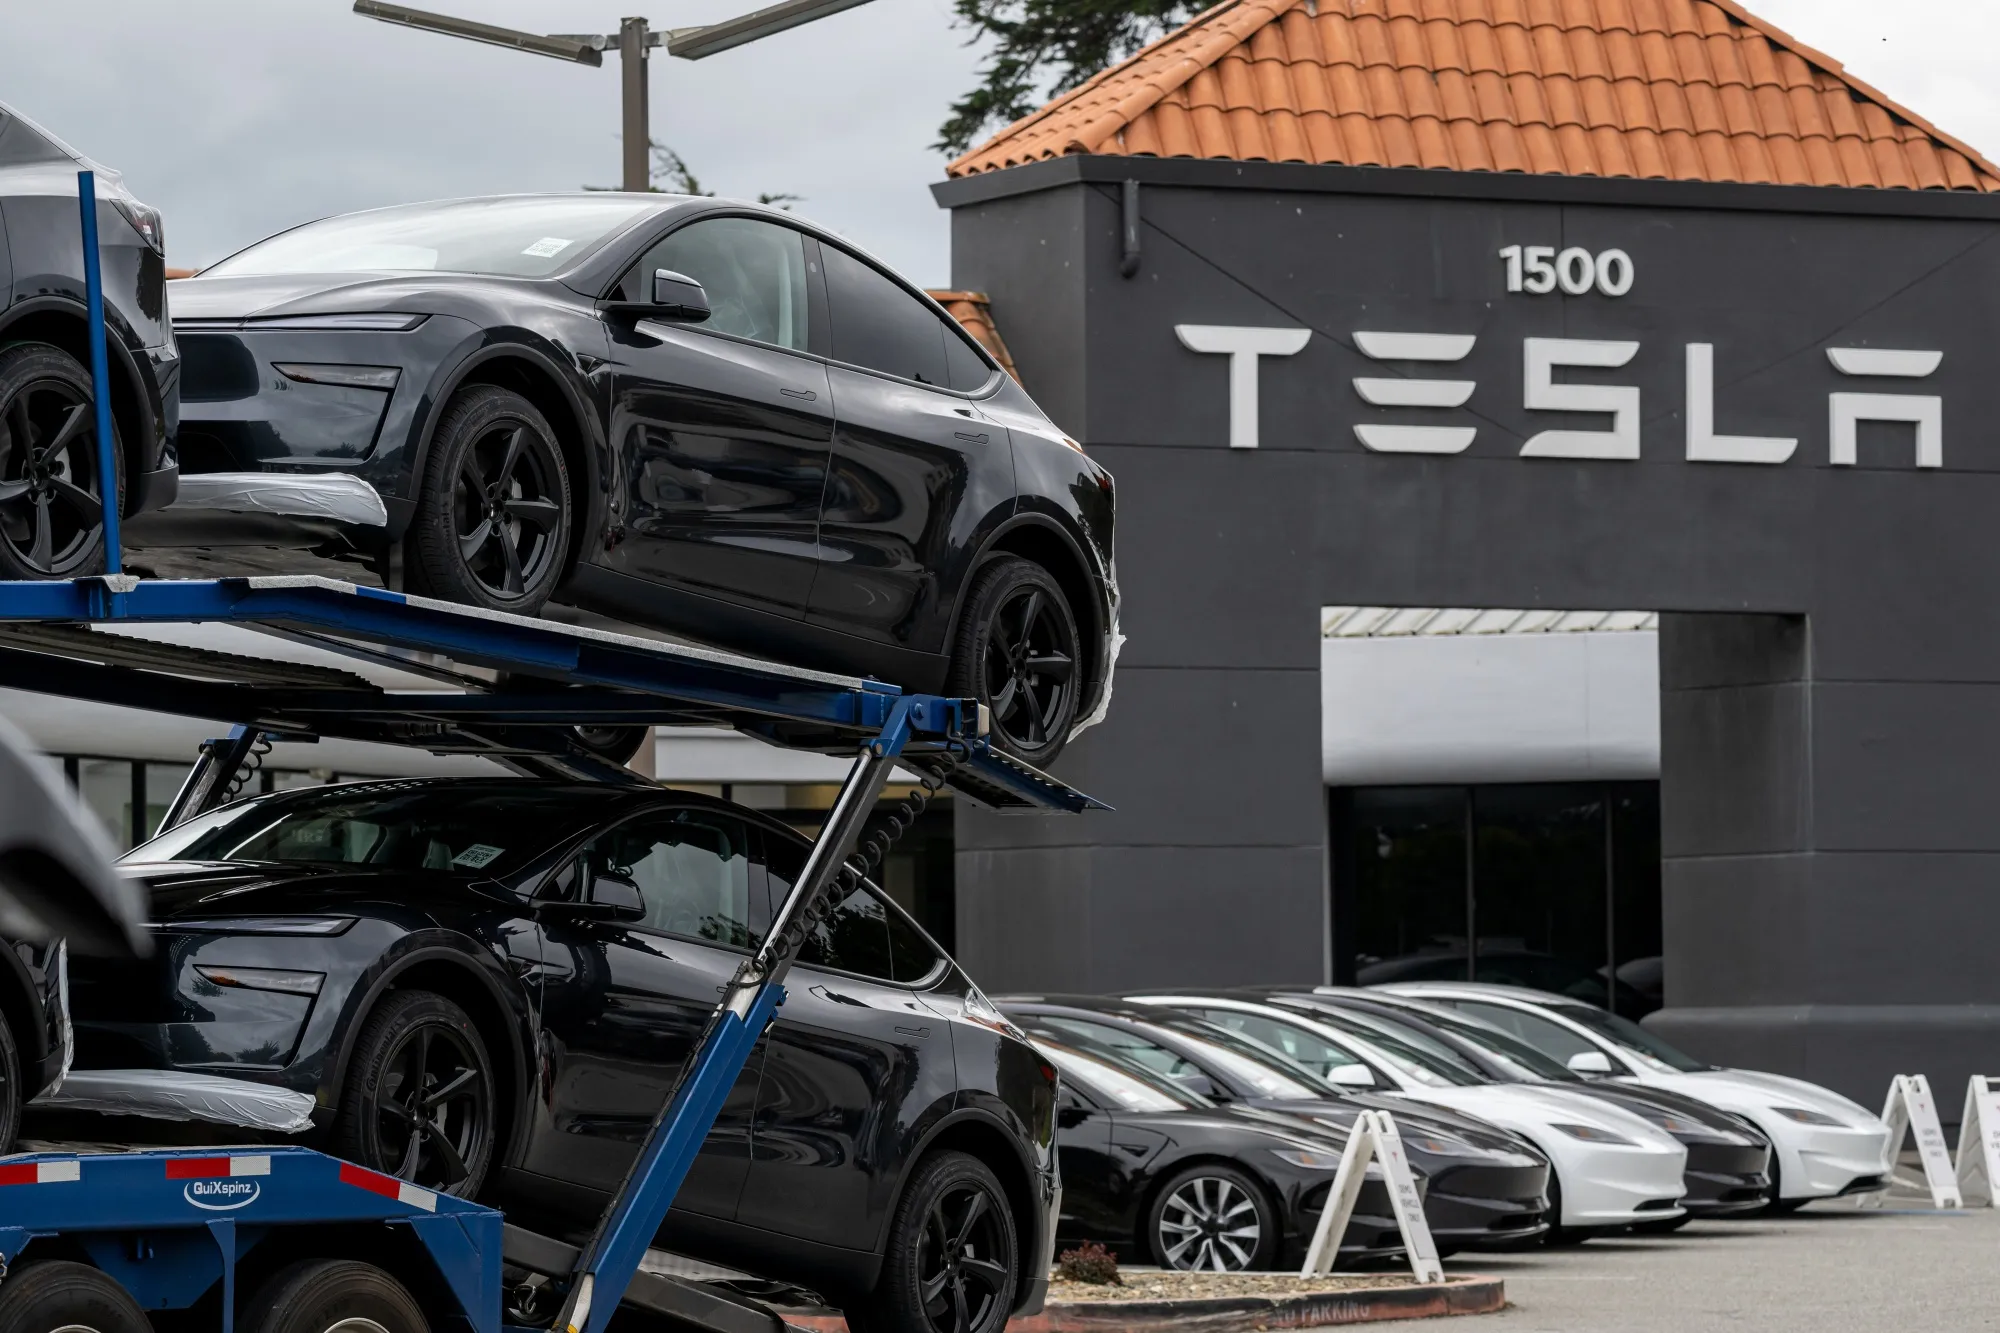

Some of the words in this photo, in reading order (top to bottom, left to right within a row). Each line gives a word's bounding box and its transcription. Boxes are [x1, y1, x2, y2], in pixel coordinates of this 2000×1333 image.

[1499, 244, 1635, 297] 1500
[1174, 323, 1944, 468] TESLA
[193, 1180, 253, 1197] QuiXspinz
[1302, 1300, 1371, 1322] PARKING
